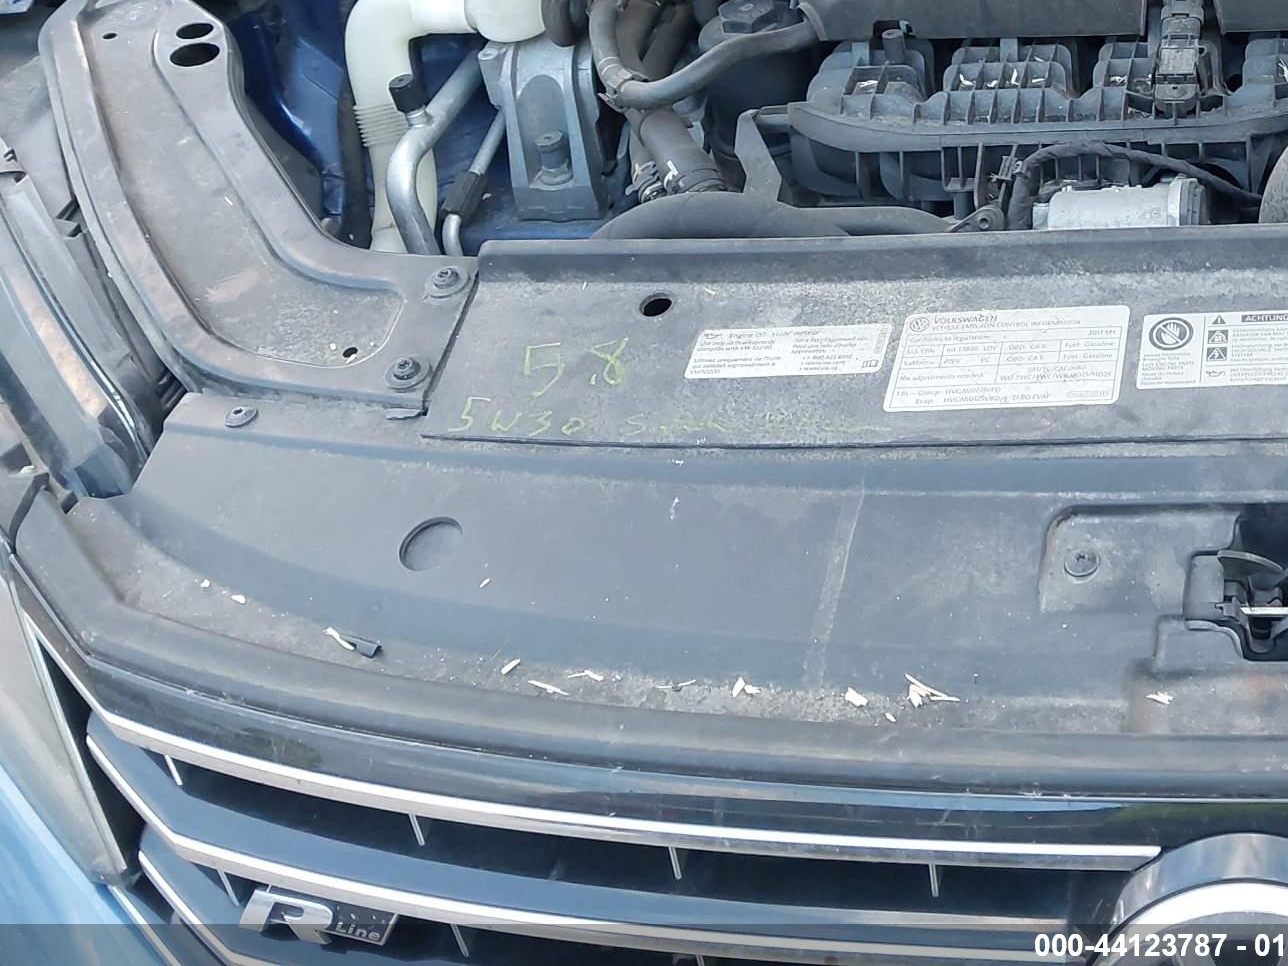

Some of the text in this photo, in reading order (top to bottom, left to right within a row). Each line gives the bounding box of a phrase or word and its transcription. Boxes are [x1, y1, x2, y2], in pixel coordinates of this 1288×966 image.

[934, 315, 998, 324] VOLKSWAGEN
[523, 338, 629, 398] 5.8
[239, 889, 382, 945] R Line
